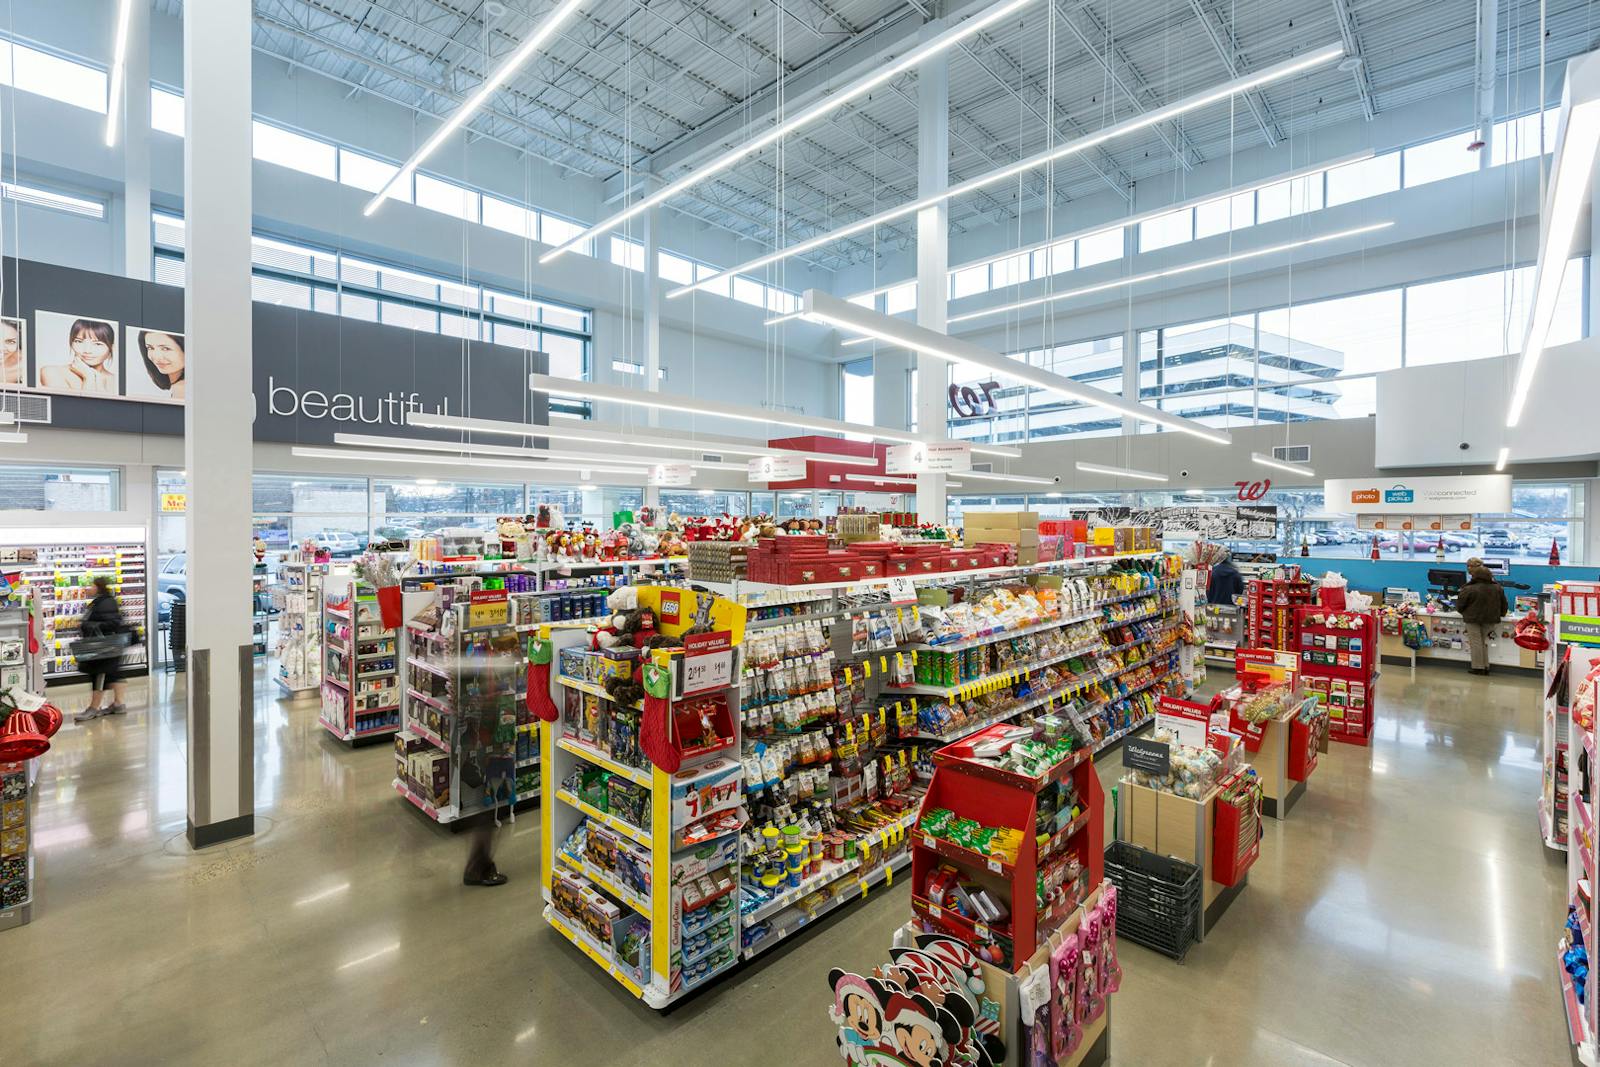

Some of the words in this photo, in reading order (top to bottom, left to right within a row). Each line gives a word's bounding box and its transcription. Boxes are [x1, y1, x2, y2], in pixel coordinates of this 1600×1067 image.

[914, 451, 923, 463] 4
[764, 463, 771, 474] 3
[662, 601, 679, 614] LEGO
[1568, 625, 1600, 633] smart
[688, 641, 708, 649] HOLIDAY
[1162, 702, 1183, 711] HOLIDAY
[1183, 706, 1202, 715] VALUES
[1128, 745, 1164, 758] Walgreens
